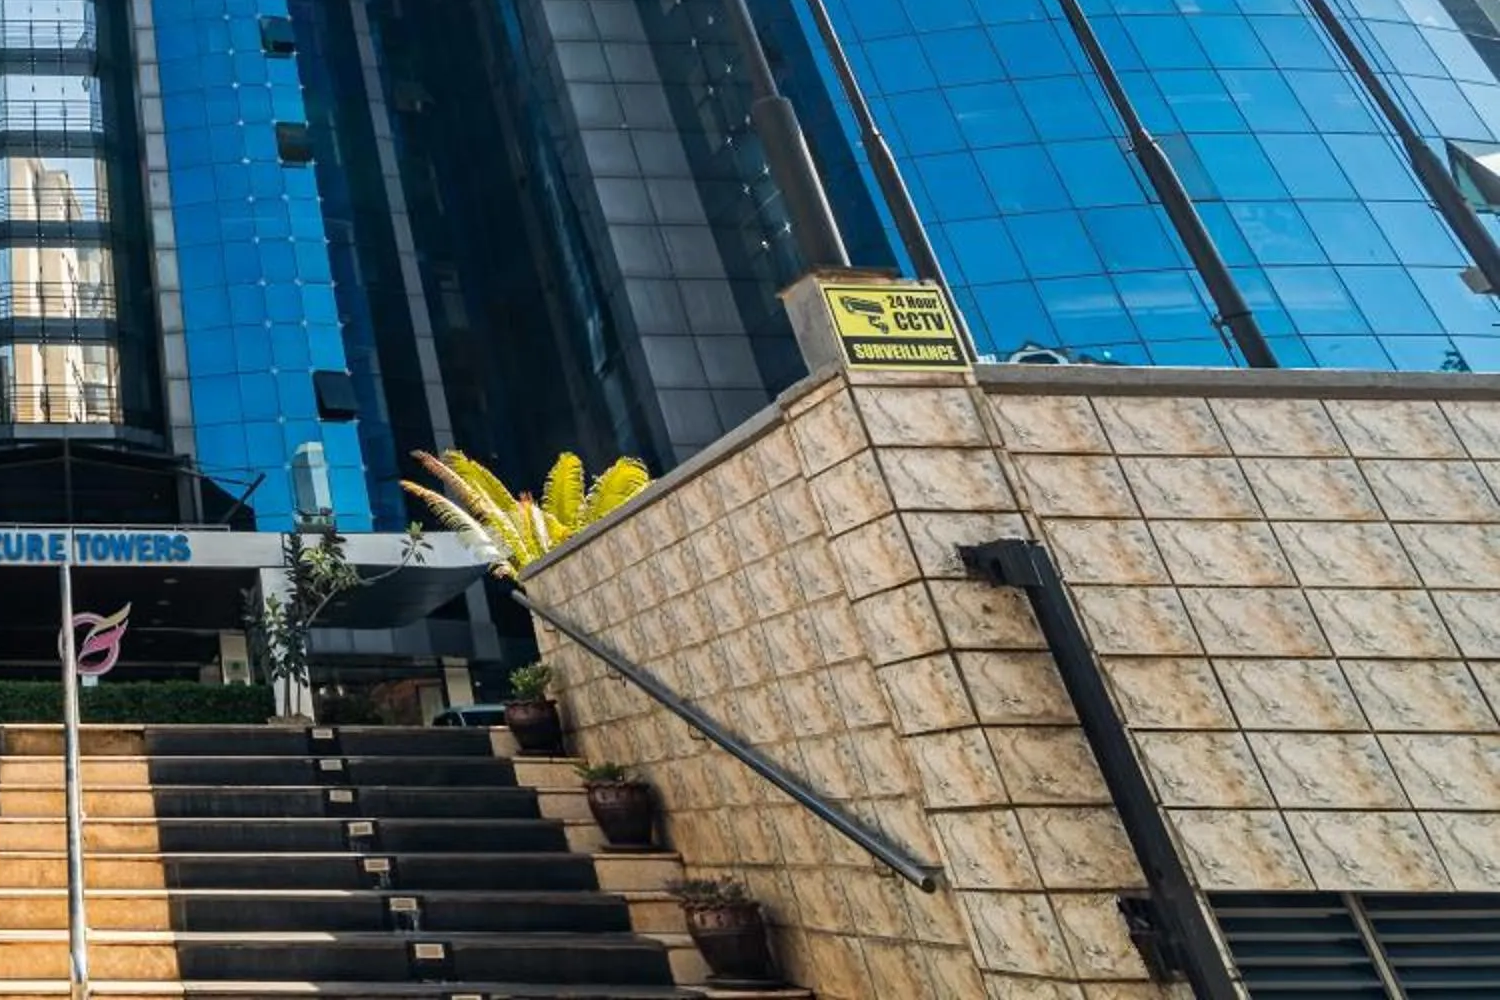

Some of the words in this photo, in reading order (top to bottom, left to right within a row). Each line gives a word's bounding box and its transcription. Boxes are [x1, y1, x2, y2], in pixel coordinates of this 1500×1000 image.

[888, 295, 904, 309] 24
[906, 295, 938, 309] Hour
[894, 312, 945, 331] CCTV
[853, 343, 957, 361] SURVEILLANCE
[74, 533, 191, 562] TOWERS
